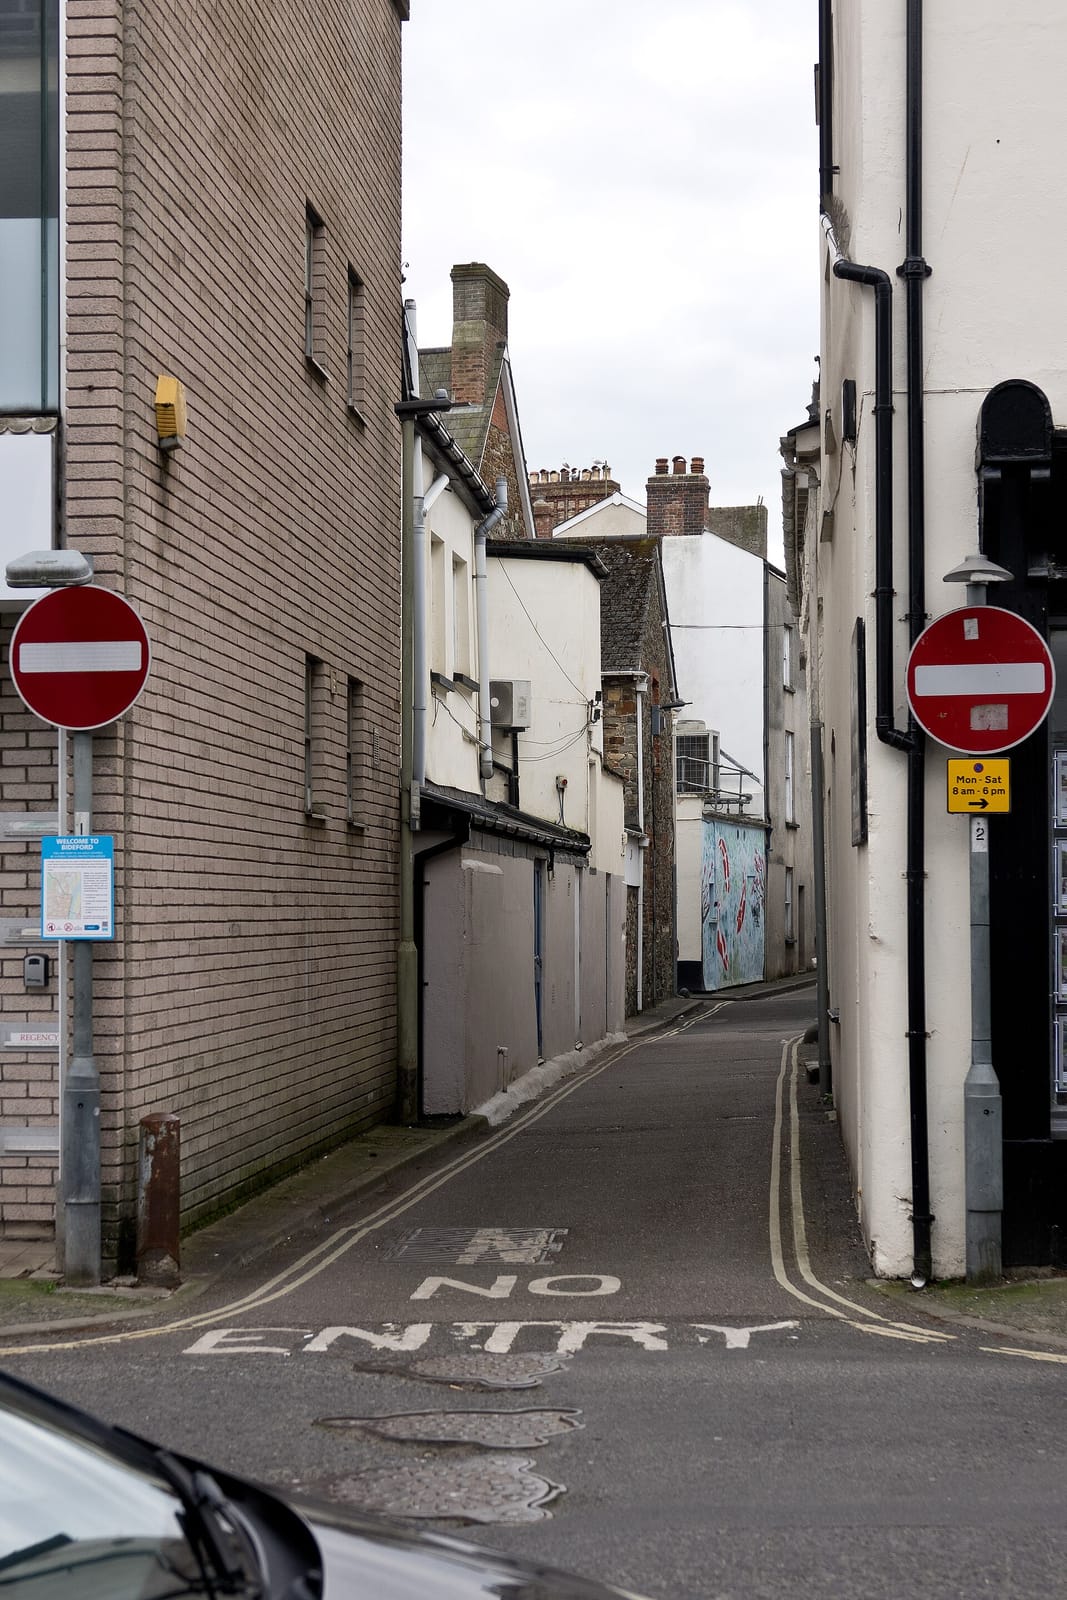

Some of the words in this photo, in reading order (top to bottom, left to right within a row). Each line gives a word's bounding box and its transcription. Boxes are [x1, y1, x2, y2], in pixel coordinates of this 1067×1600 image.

[952, 787, 958, 795] 8
[983, 787, 988, 795] 6
[976, 827, 984, 841] 2
[20, 1033, 59, 1041] REGENCY
[409, 1274, 621, 1300] NO
[181, 1319, 800, 1355] ENTRY
